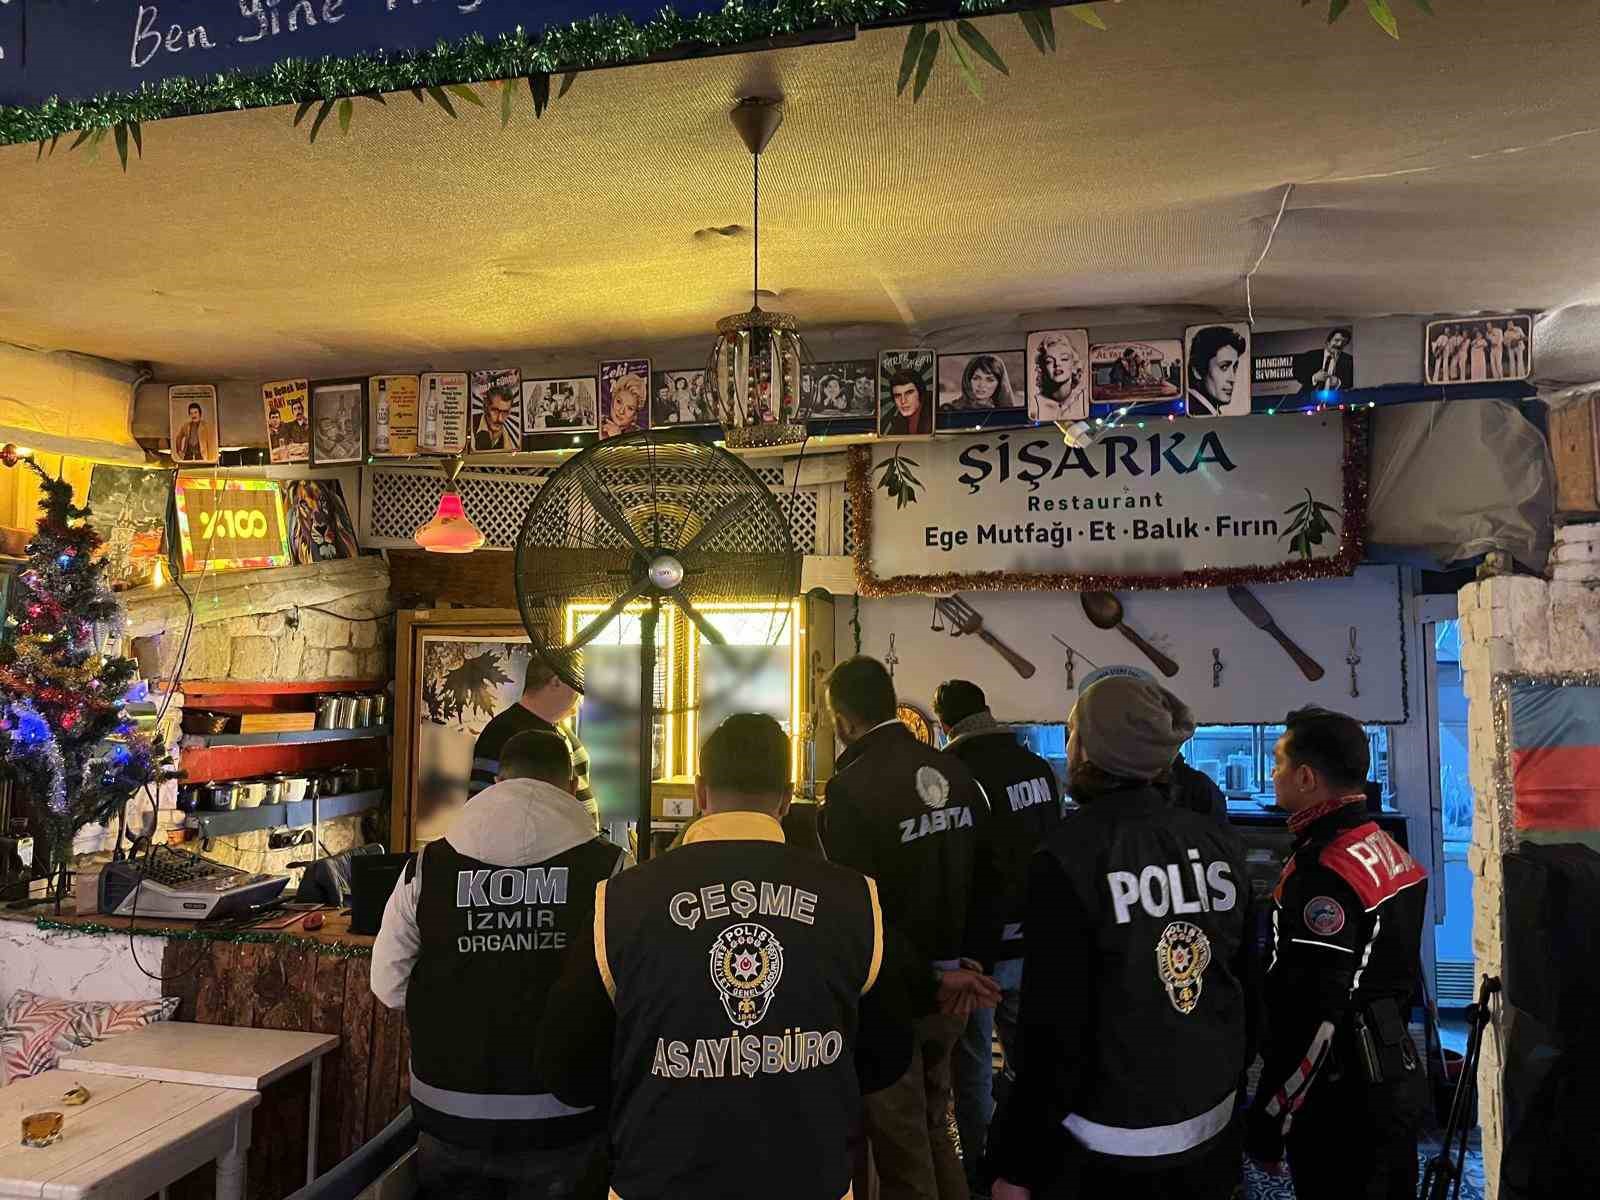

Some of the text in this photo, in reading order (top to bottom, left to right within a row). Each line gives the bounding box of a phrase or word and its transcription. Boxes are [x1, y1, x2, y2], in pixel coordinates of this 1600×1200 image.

[130, 4, 216, 69] Ben
[958, 429, 1238, 494] ŞİŞARKA
[1027, 491, 1164, 512] Restaurant
[925, 515, 1278, 551] Ege Mutfağı Et Balık Fırın
[1005, 777, 1052, 812] KOM
[456, 866, 569, 908] KOM
[1107, 848, 1237, 925] POLİS
[467, 907, 555, 931] İZMİR
[669, 880, 818, 930] ÇEŞME
[457, 930, 568, 953] ORGANİZE
[725, 926, 768, 941] POLİS
